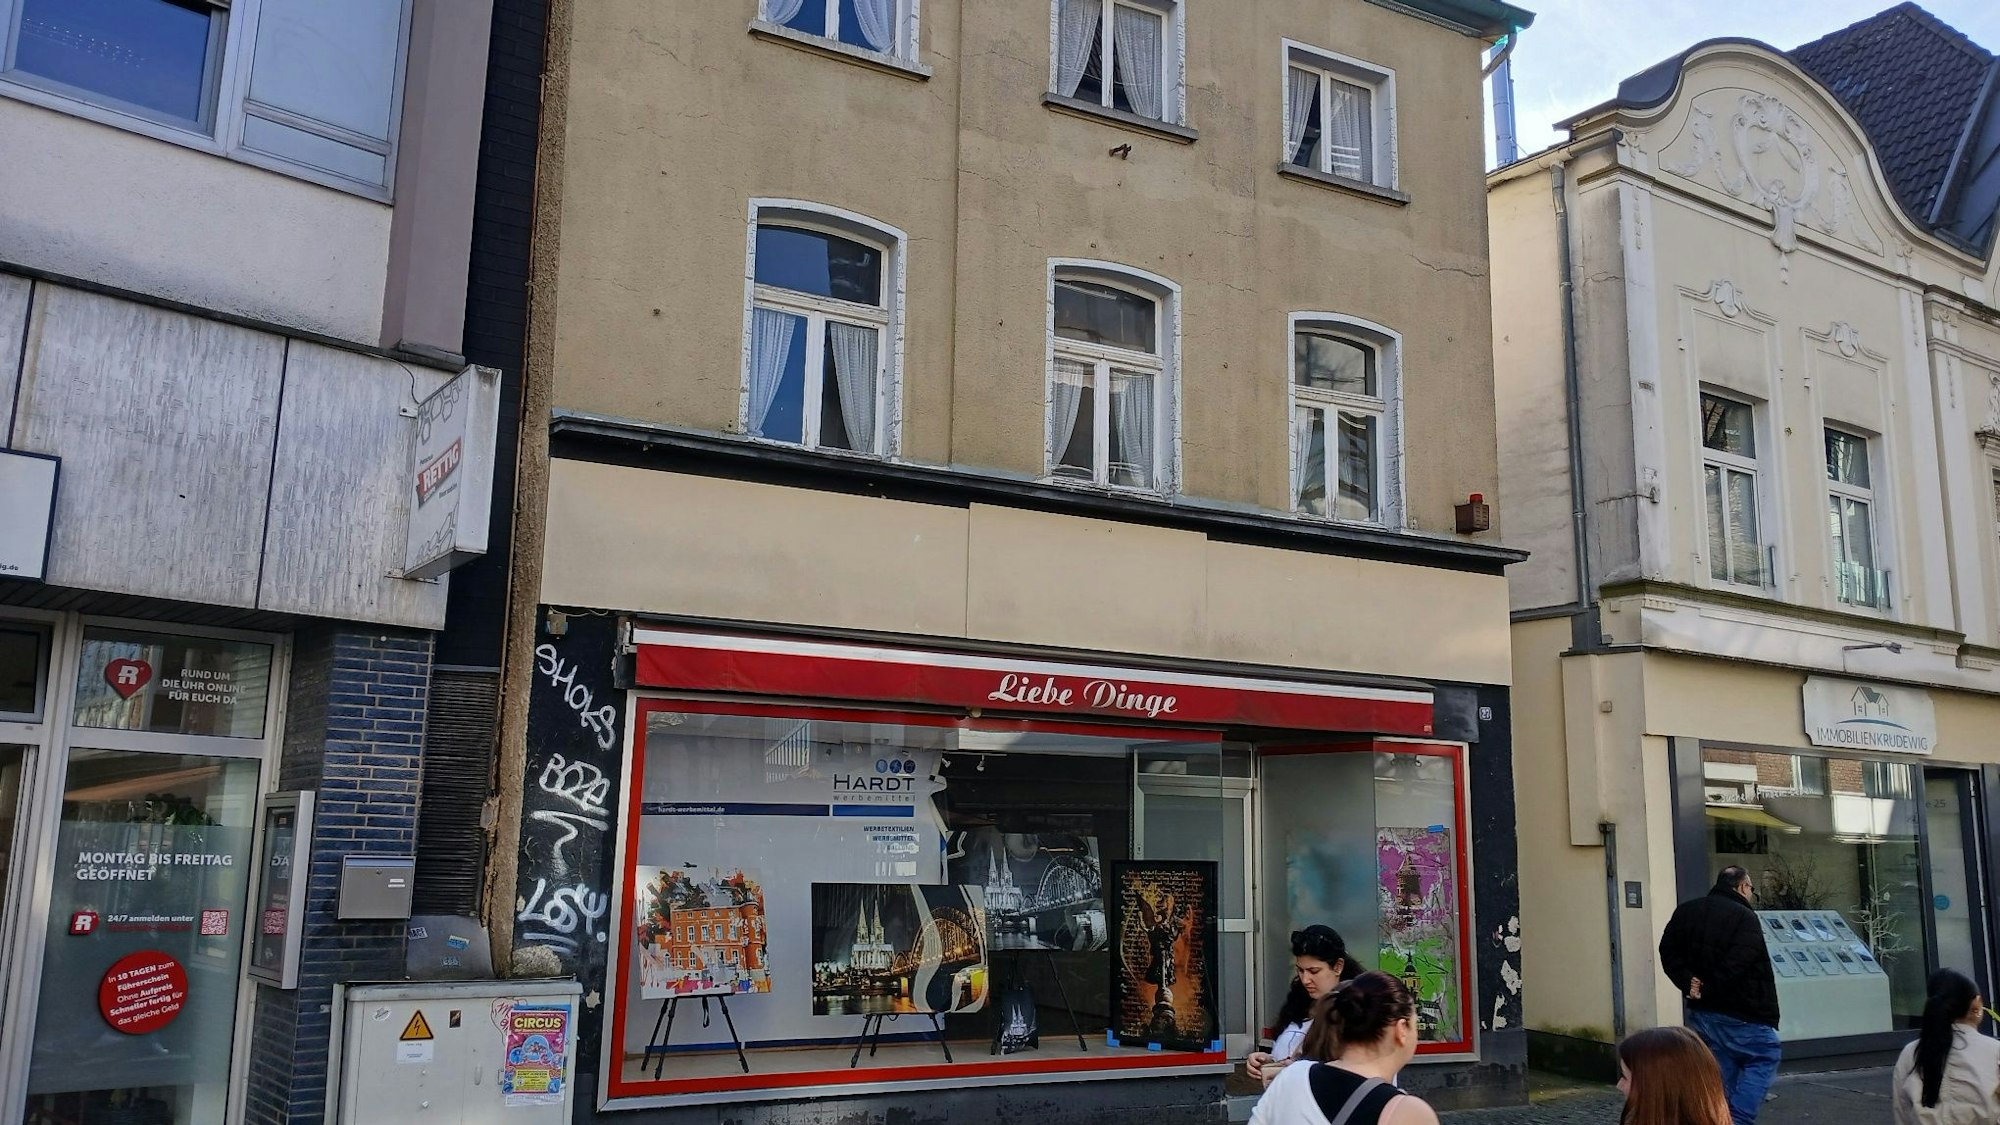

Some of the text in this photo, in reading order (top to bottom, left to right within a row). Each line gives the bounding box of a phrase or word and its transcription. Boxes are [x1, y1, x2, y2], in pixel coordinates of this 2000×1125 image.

[422, 443, 460, 492] RETTIG
[181, 668, 231, 681] RUND UM
[162, 679, 246, 693] DIE UHR ONLINE
[168, 690, 237, 705] FÜR EUCH DA
[987, 673, 1178, 718] Liebe Dinge
[833, 773, 916, 791] HARDT
[833, 794, 916, 802] werbemittel
[78, 851, 233, 866] MONTAG BIS FREITAG
[76, 866, 154, 881] GEÖFFNET
[128, 914, 169, 922] anmelden
[108, 961, 175, 984] In 10 TAGEN zum
[117, 973, 169, 992] Führerschein
[117, 983, 173, 1003] Ohne Aufpreis
[109, 991, 183, 1017] Schneller fertig für
[117, 1003, 180, 1025] das gleiche Geld
[514, 1017, 562, 1029] CIRCUS
